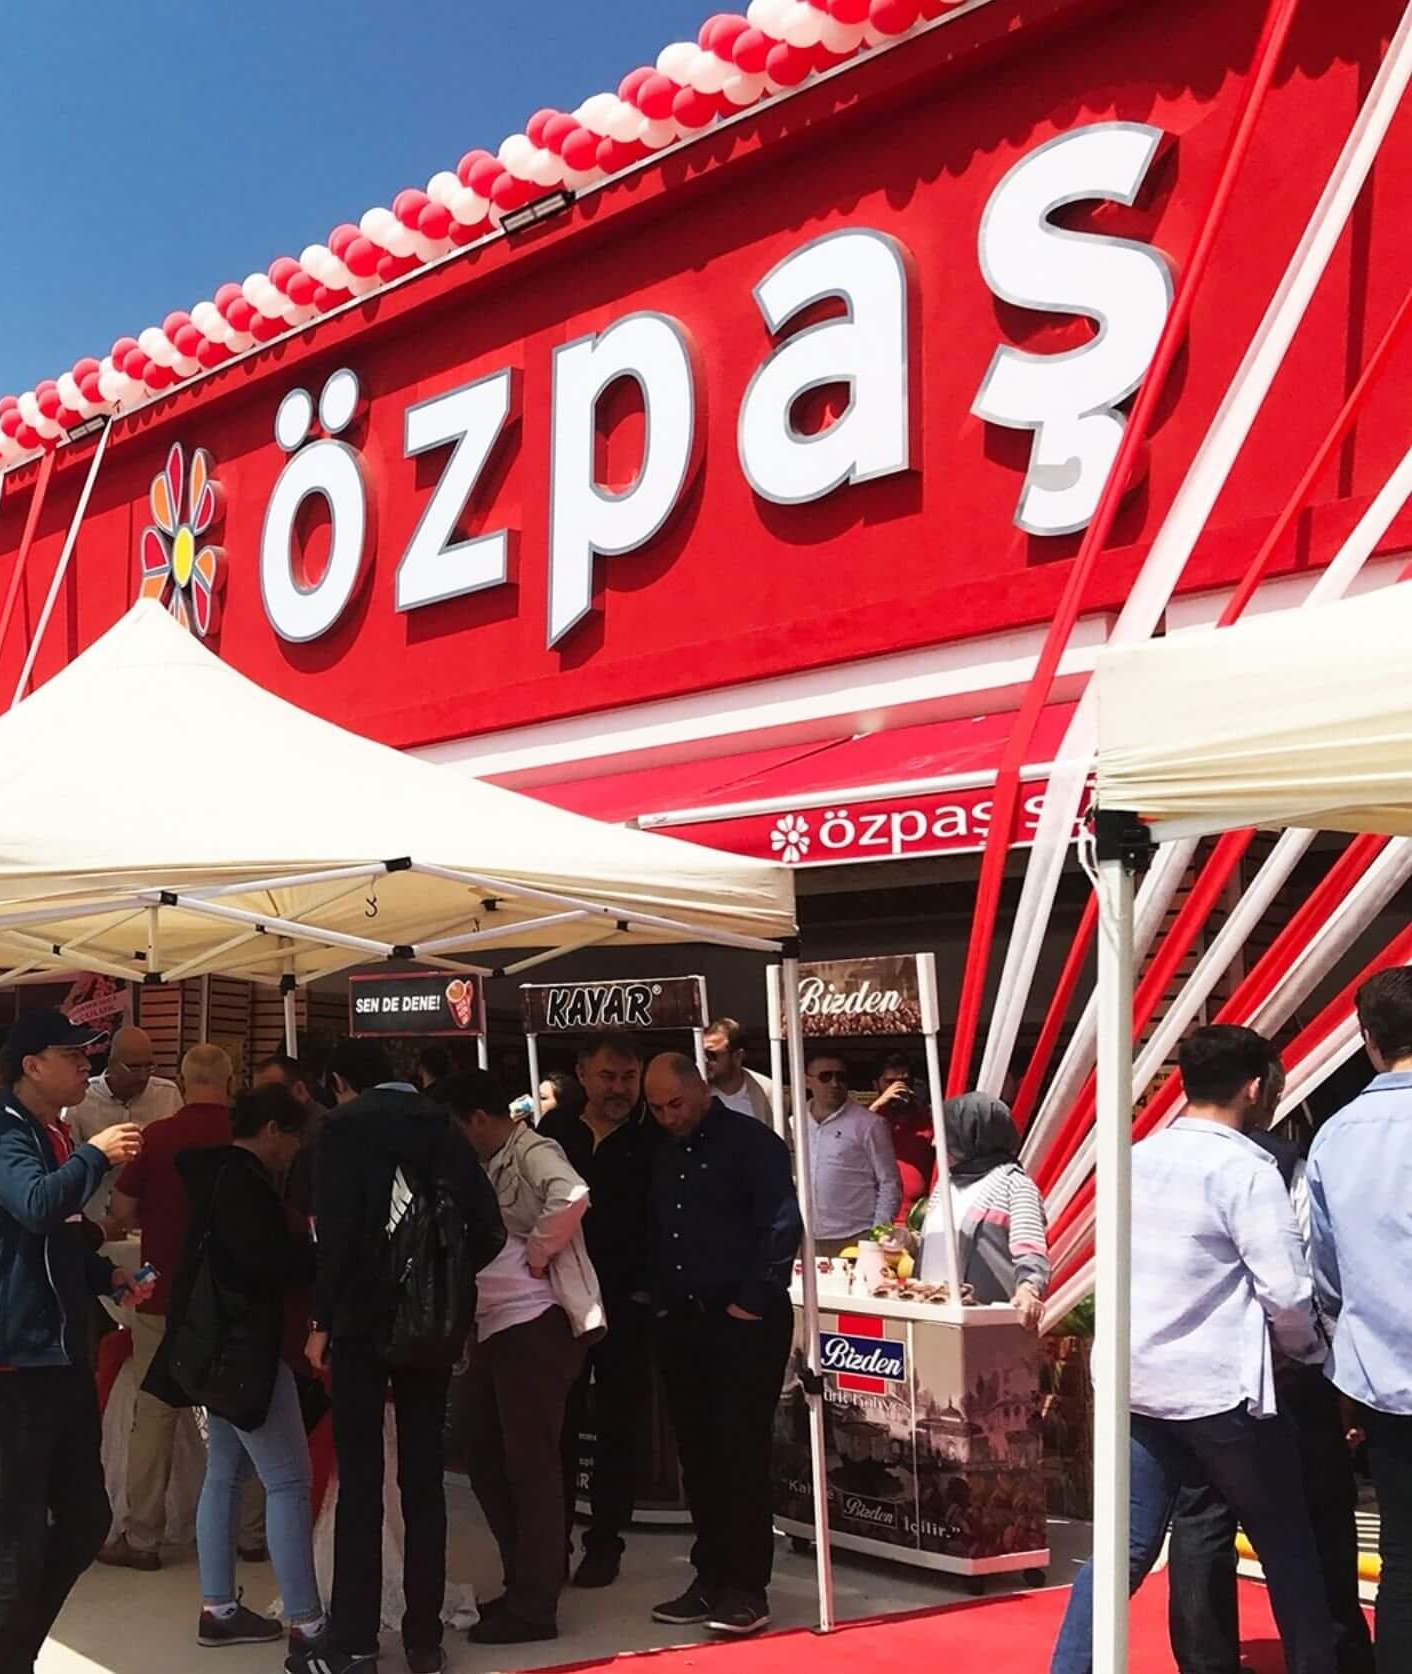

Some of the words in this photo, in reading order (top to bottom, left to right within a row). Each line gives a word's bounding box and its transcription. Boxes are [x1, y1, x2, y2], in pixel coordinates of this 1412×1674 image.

[258, 120, 1178, 648] özpaş
[355, 997, 380, 1014] SEN
[381, 996, 400, 1013] DE
[402, 994, 441, 1012] DENE!
[546, 984, 653, 1029] KAYAR
[797, 976, 902, 1016] Bizden
[820, 1337, 903, 1377] Bizden
[843, 1496, 894, 1525] Bizden
